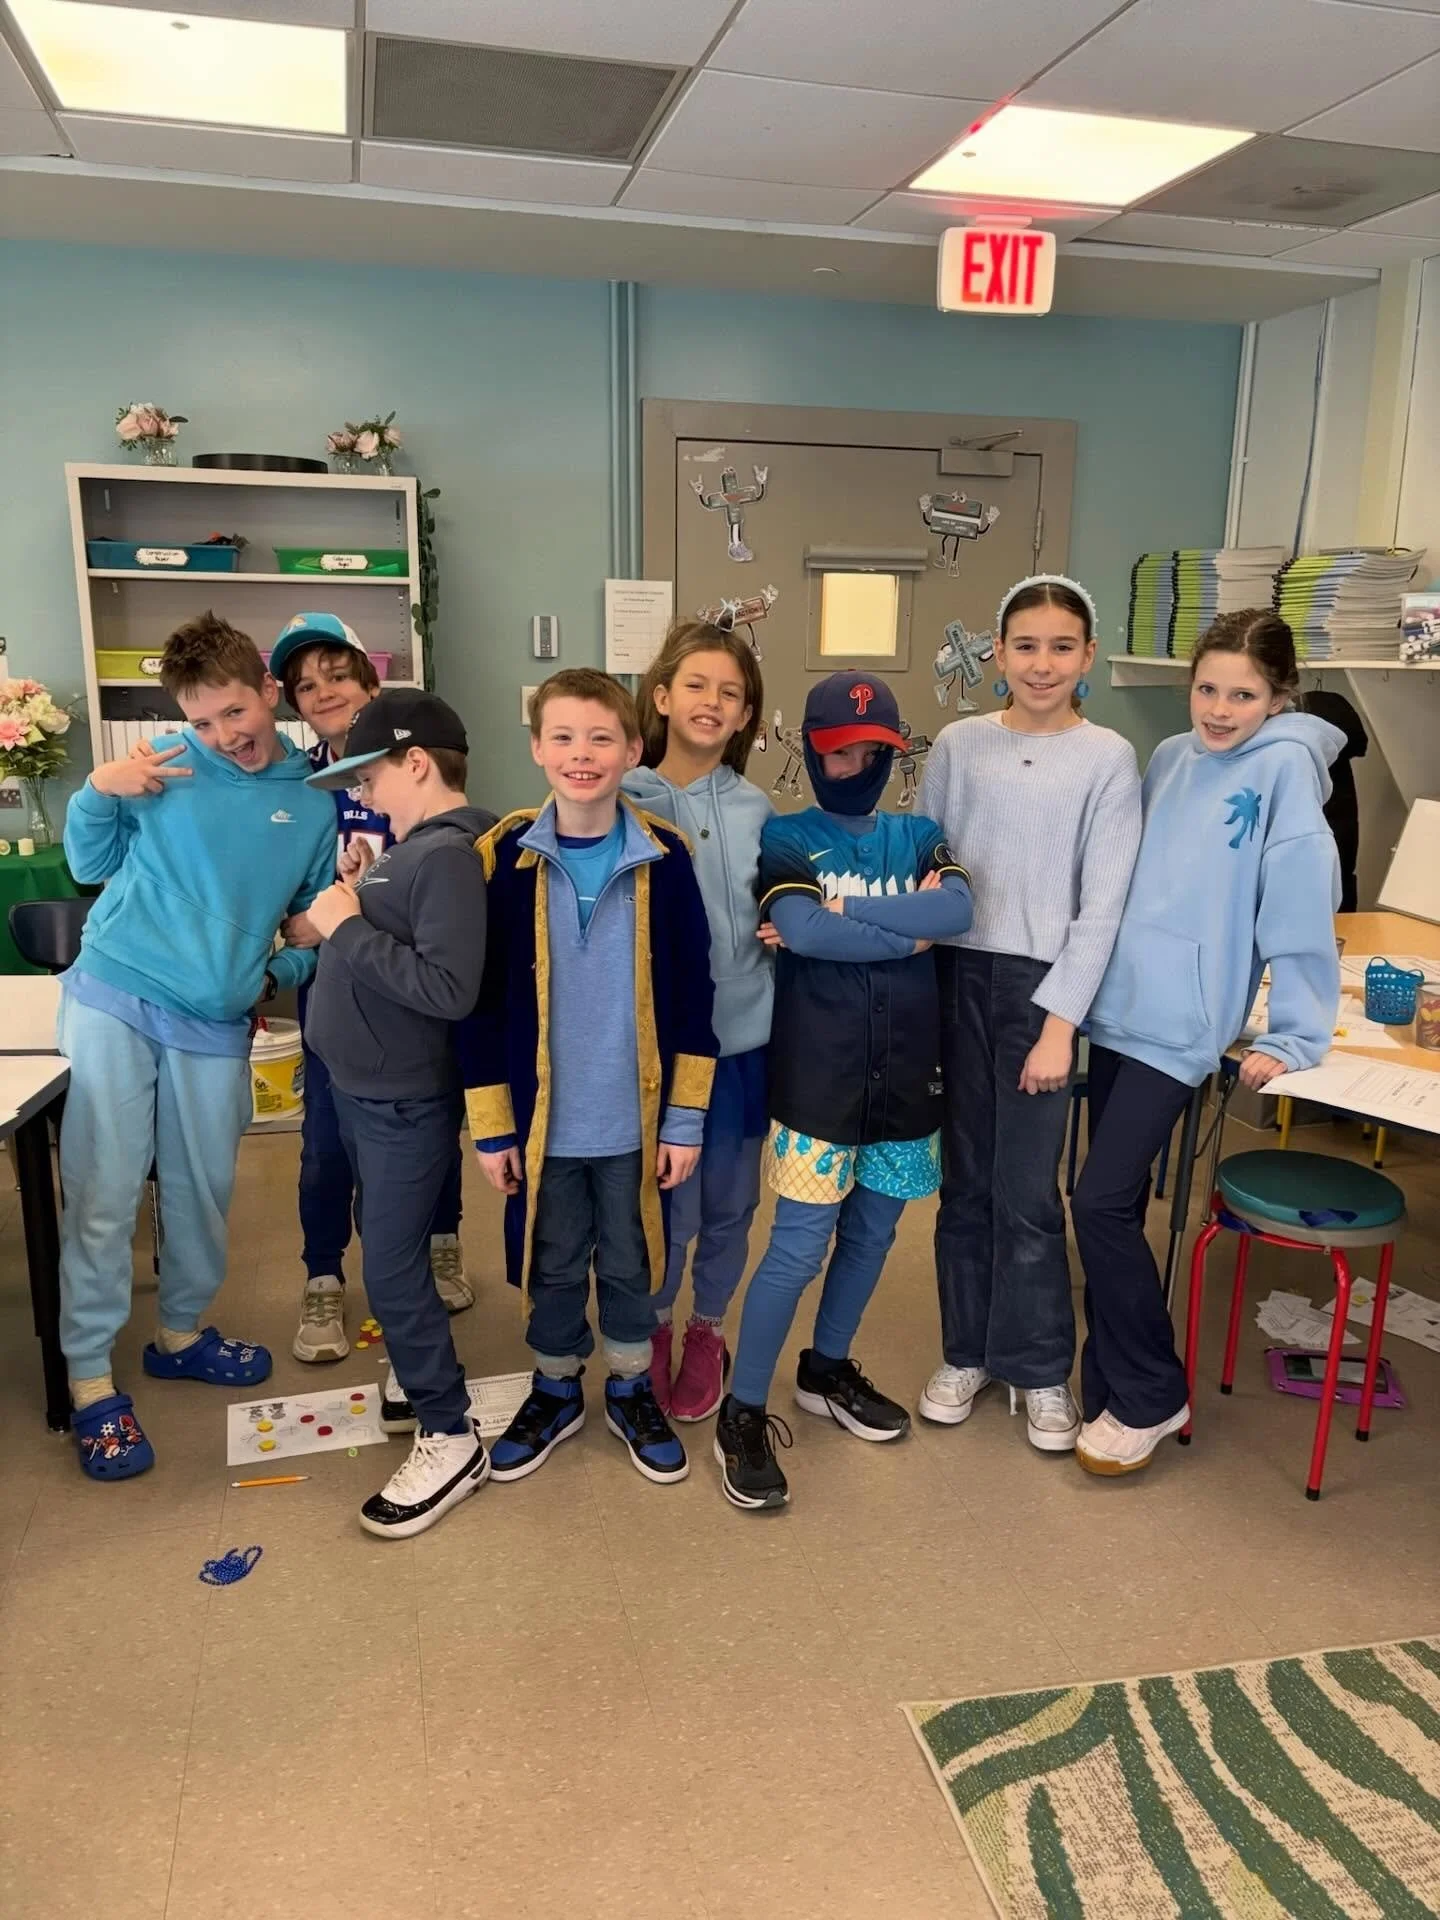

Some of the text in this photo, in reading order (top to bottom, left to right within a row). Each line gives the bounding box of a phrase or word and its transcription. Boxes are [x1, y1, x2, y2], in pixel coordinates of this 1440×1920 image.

[962, 232, 1043, 305] EXIT
[951, 630, 977, 678] MULTIPLICATION
[849, 683, 874, 716] P
